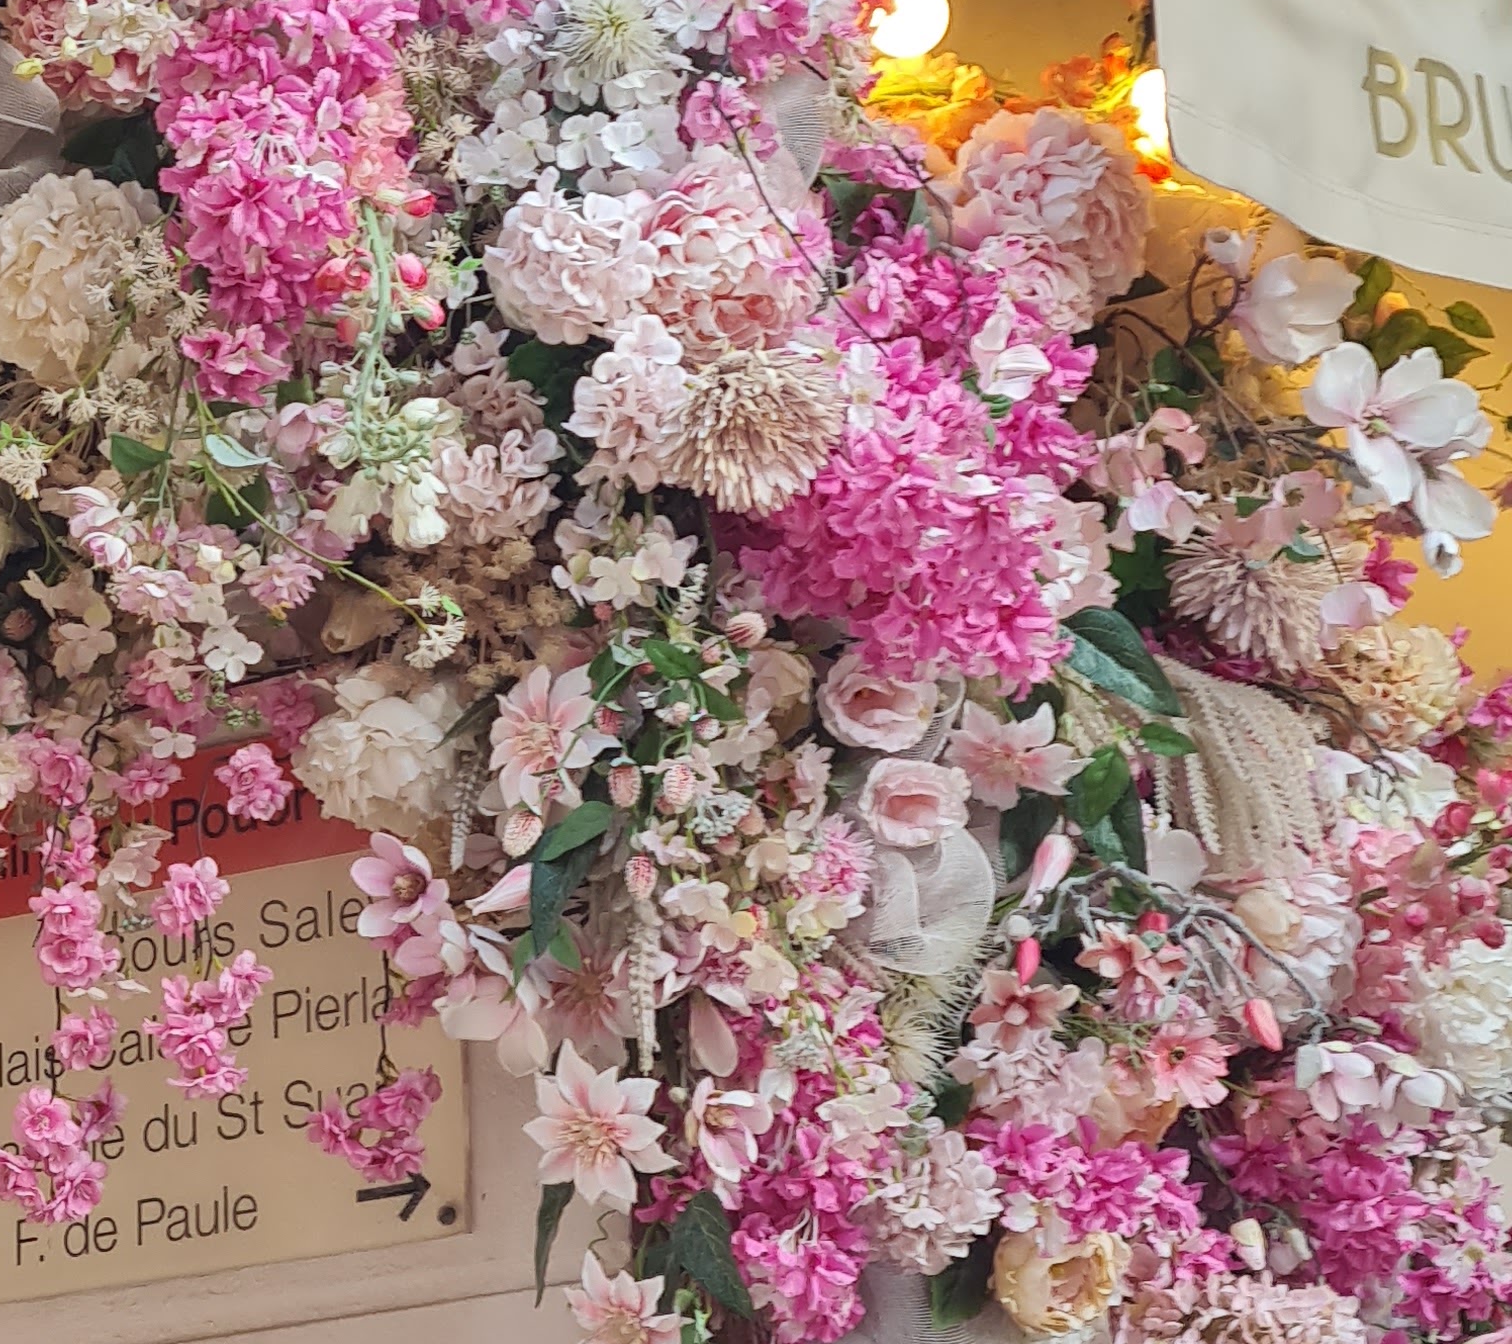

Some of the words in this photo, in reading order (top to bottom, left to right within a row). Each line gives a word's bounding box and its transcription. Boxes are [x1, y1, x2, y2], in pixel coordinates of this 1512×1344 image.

[259, 890, 374, 948] Sale
[273, 976, 402, 1039] Pierla
[143, 1103, 198, 1153] du
[217, 1091, 265, 1141] St
[63, 1215, 118, 1257] de
[136, 1185, 258, 1245] Paule
